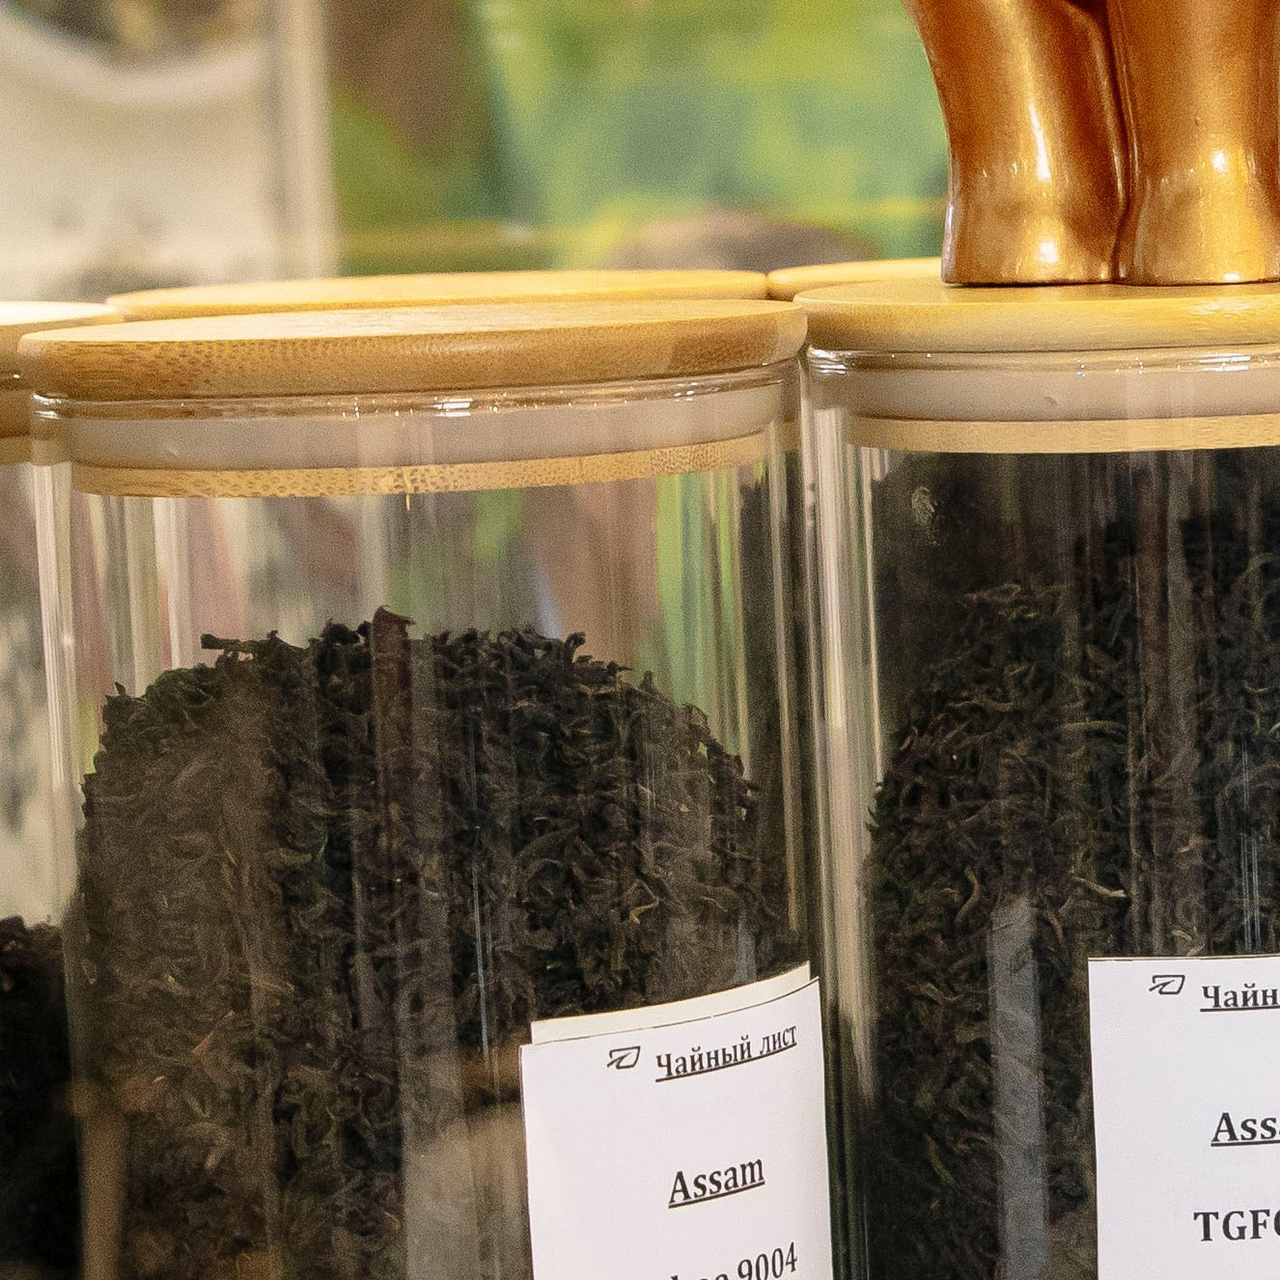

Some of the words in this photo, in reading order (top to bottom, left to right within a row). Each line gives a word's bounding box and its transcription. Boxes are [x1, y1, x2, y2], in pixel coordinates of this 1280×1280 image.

[656, 1035, 755, 1080] Чайный
[759, 1023, 798, 1057] лист
[669, 1158, 765, 1205] Assam
